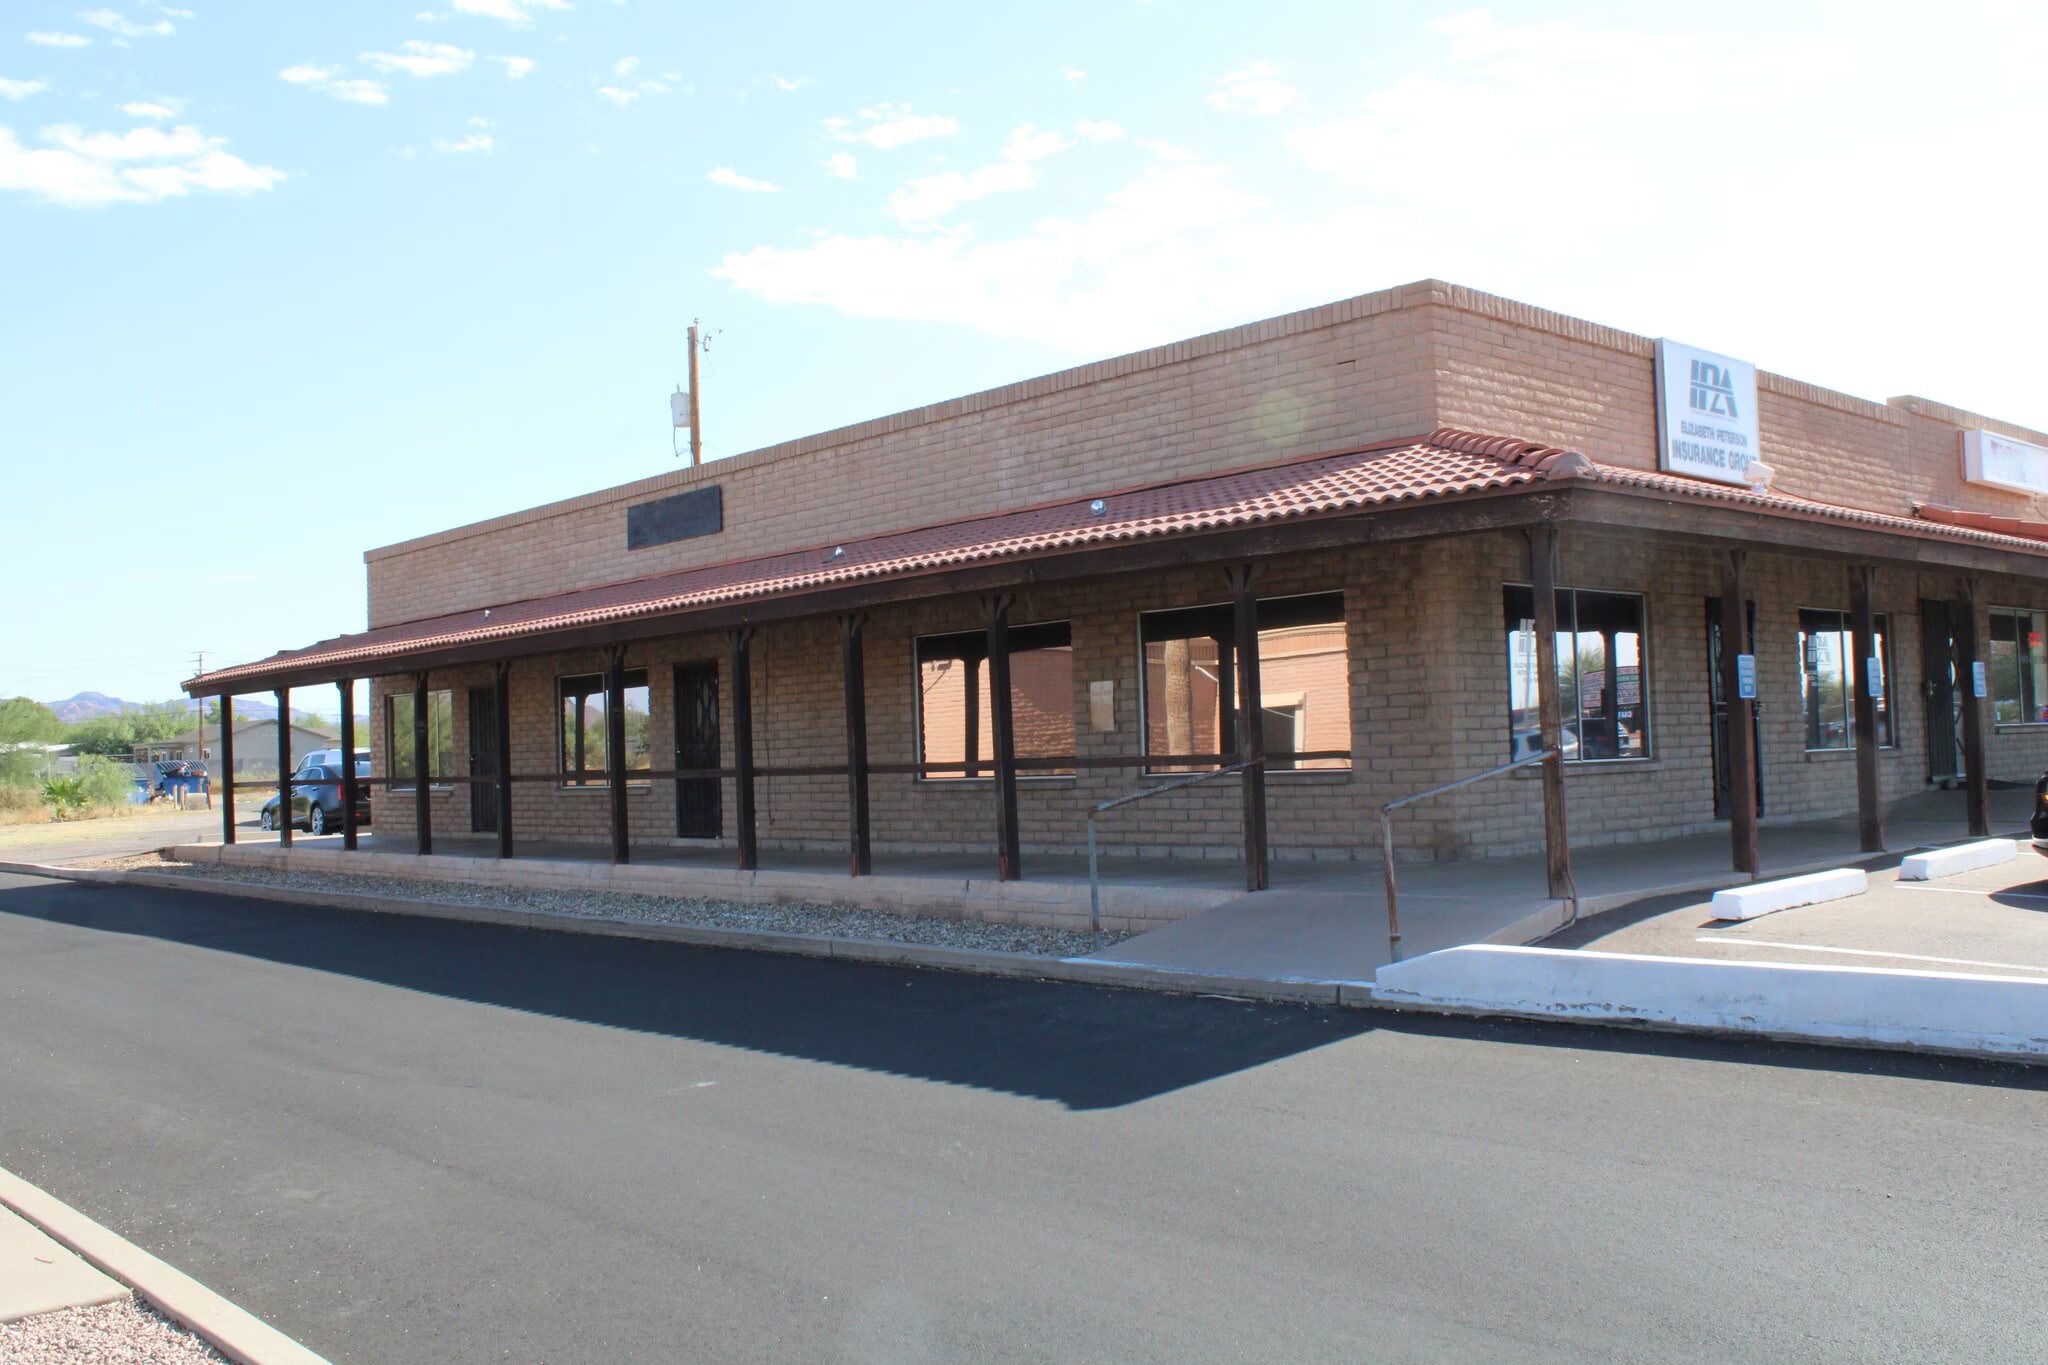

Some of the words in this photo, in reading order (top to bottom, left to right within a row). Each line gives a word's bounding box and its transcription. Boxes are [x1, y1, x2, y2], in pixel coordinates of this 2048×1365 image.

[1681, 421, 1715, 440] ELIZABETH
[1716, 429, 1748, 448] PETERSON
[1672, 439, 1726, 467] INSURANCE
